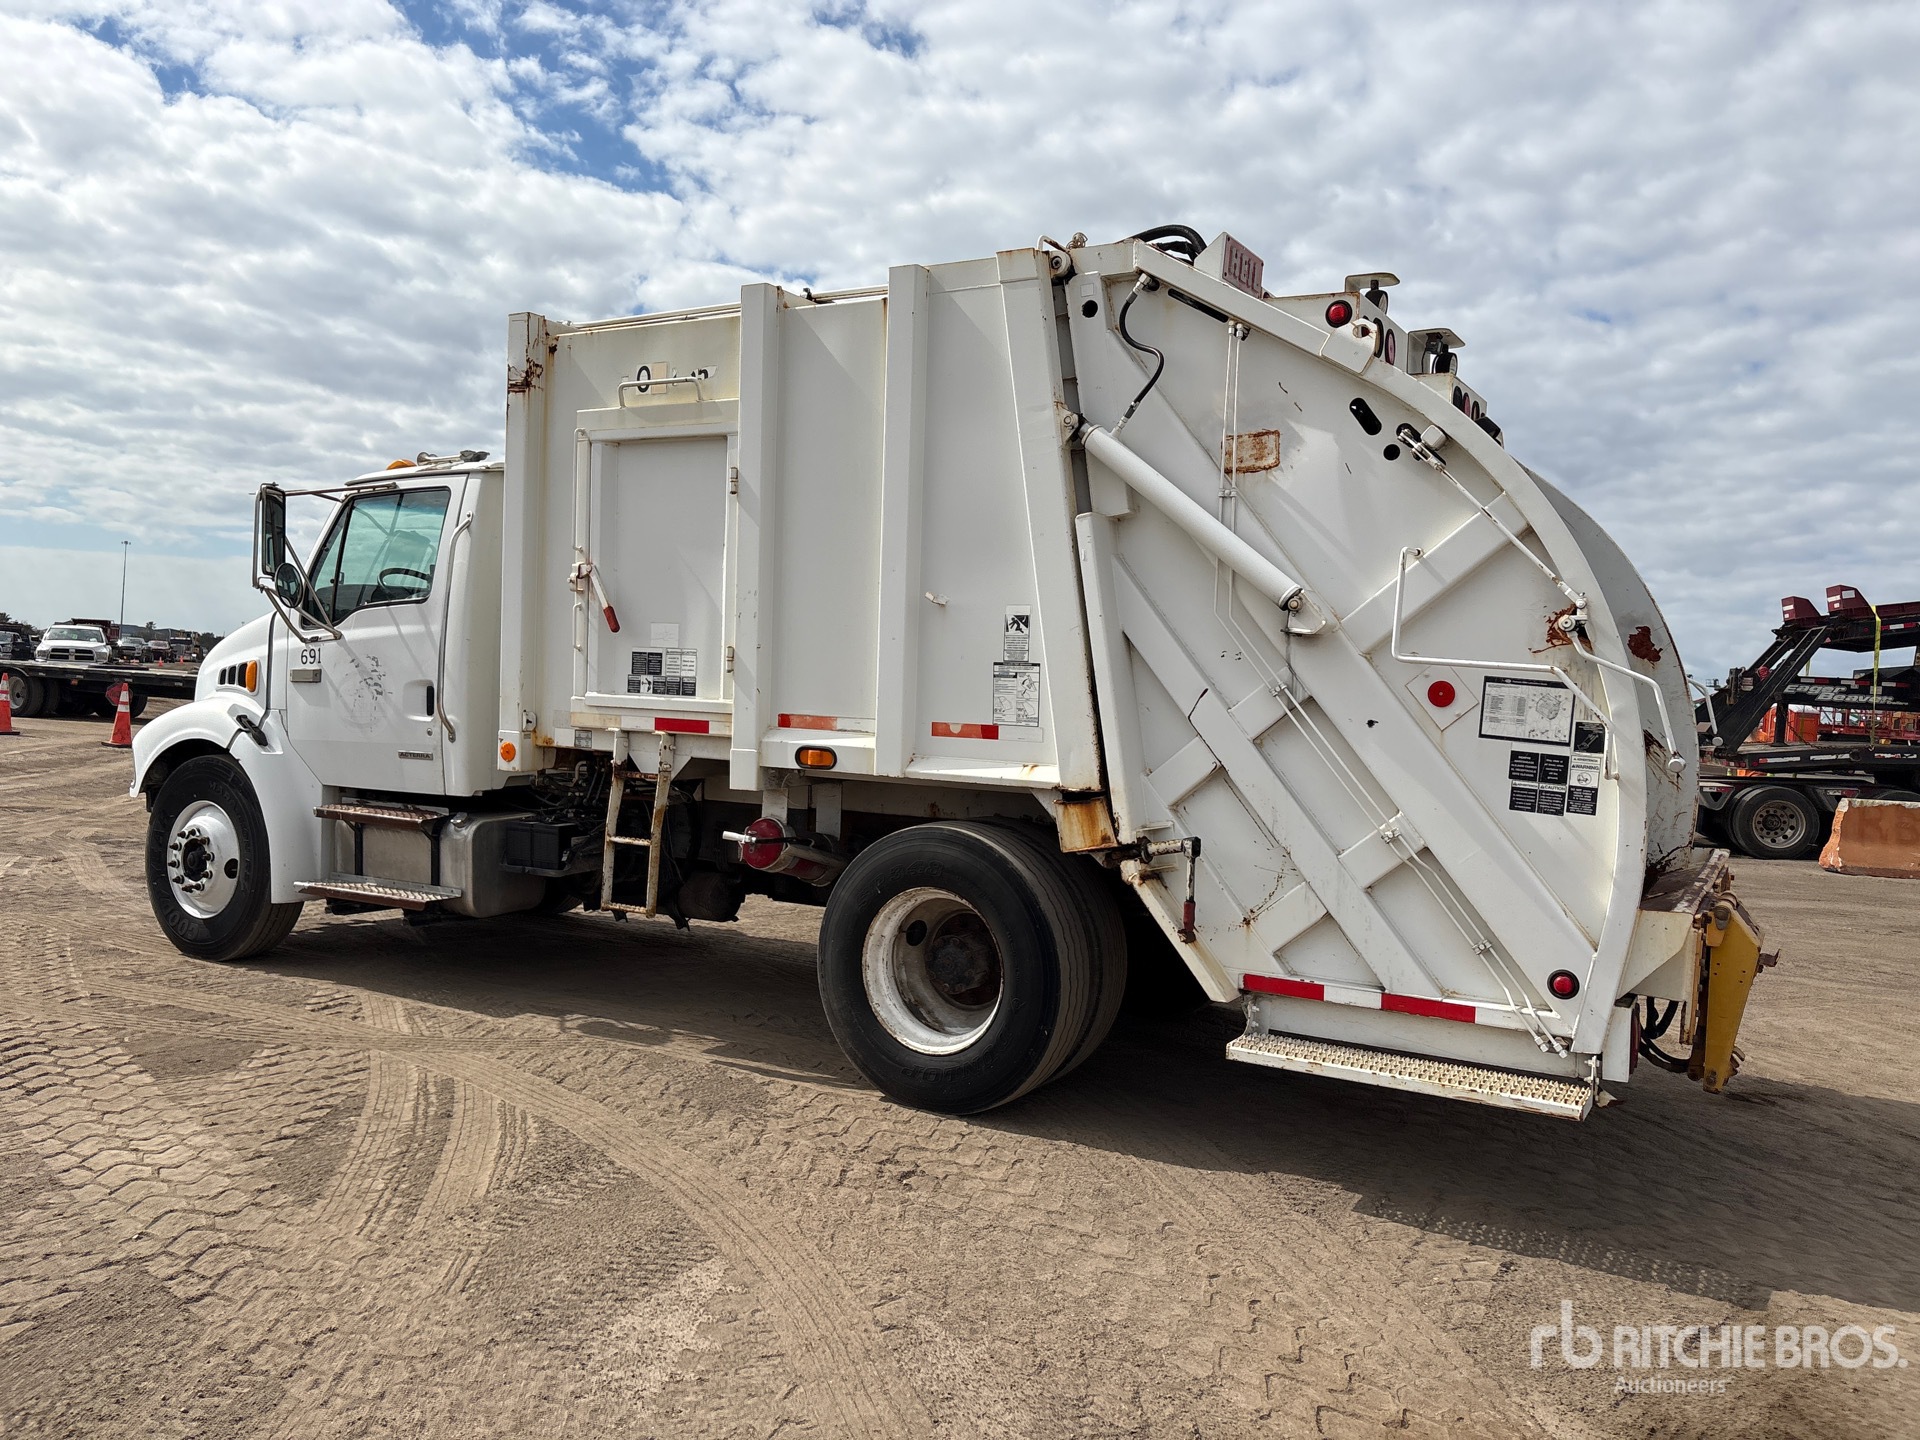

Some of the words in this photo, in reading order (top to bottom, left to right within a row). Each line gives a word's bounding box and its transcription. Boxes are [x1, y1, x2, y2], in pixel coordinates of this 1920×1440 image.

[300, 647, 321, 665] 691
[1783, 684, 1847, 696] Eager
[1815, 692, 1894, 704] Beaver
[399, 751, 431, 759] ACTERRA
[1576, 763, 1599, 771] WARNING
